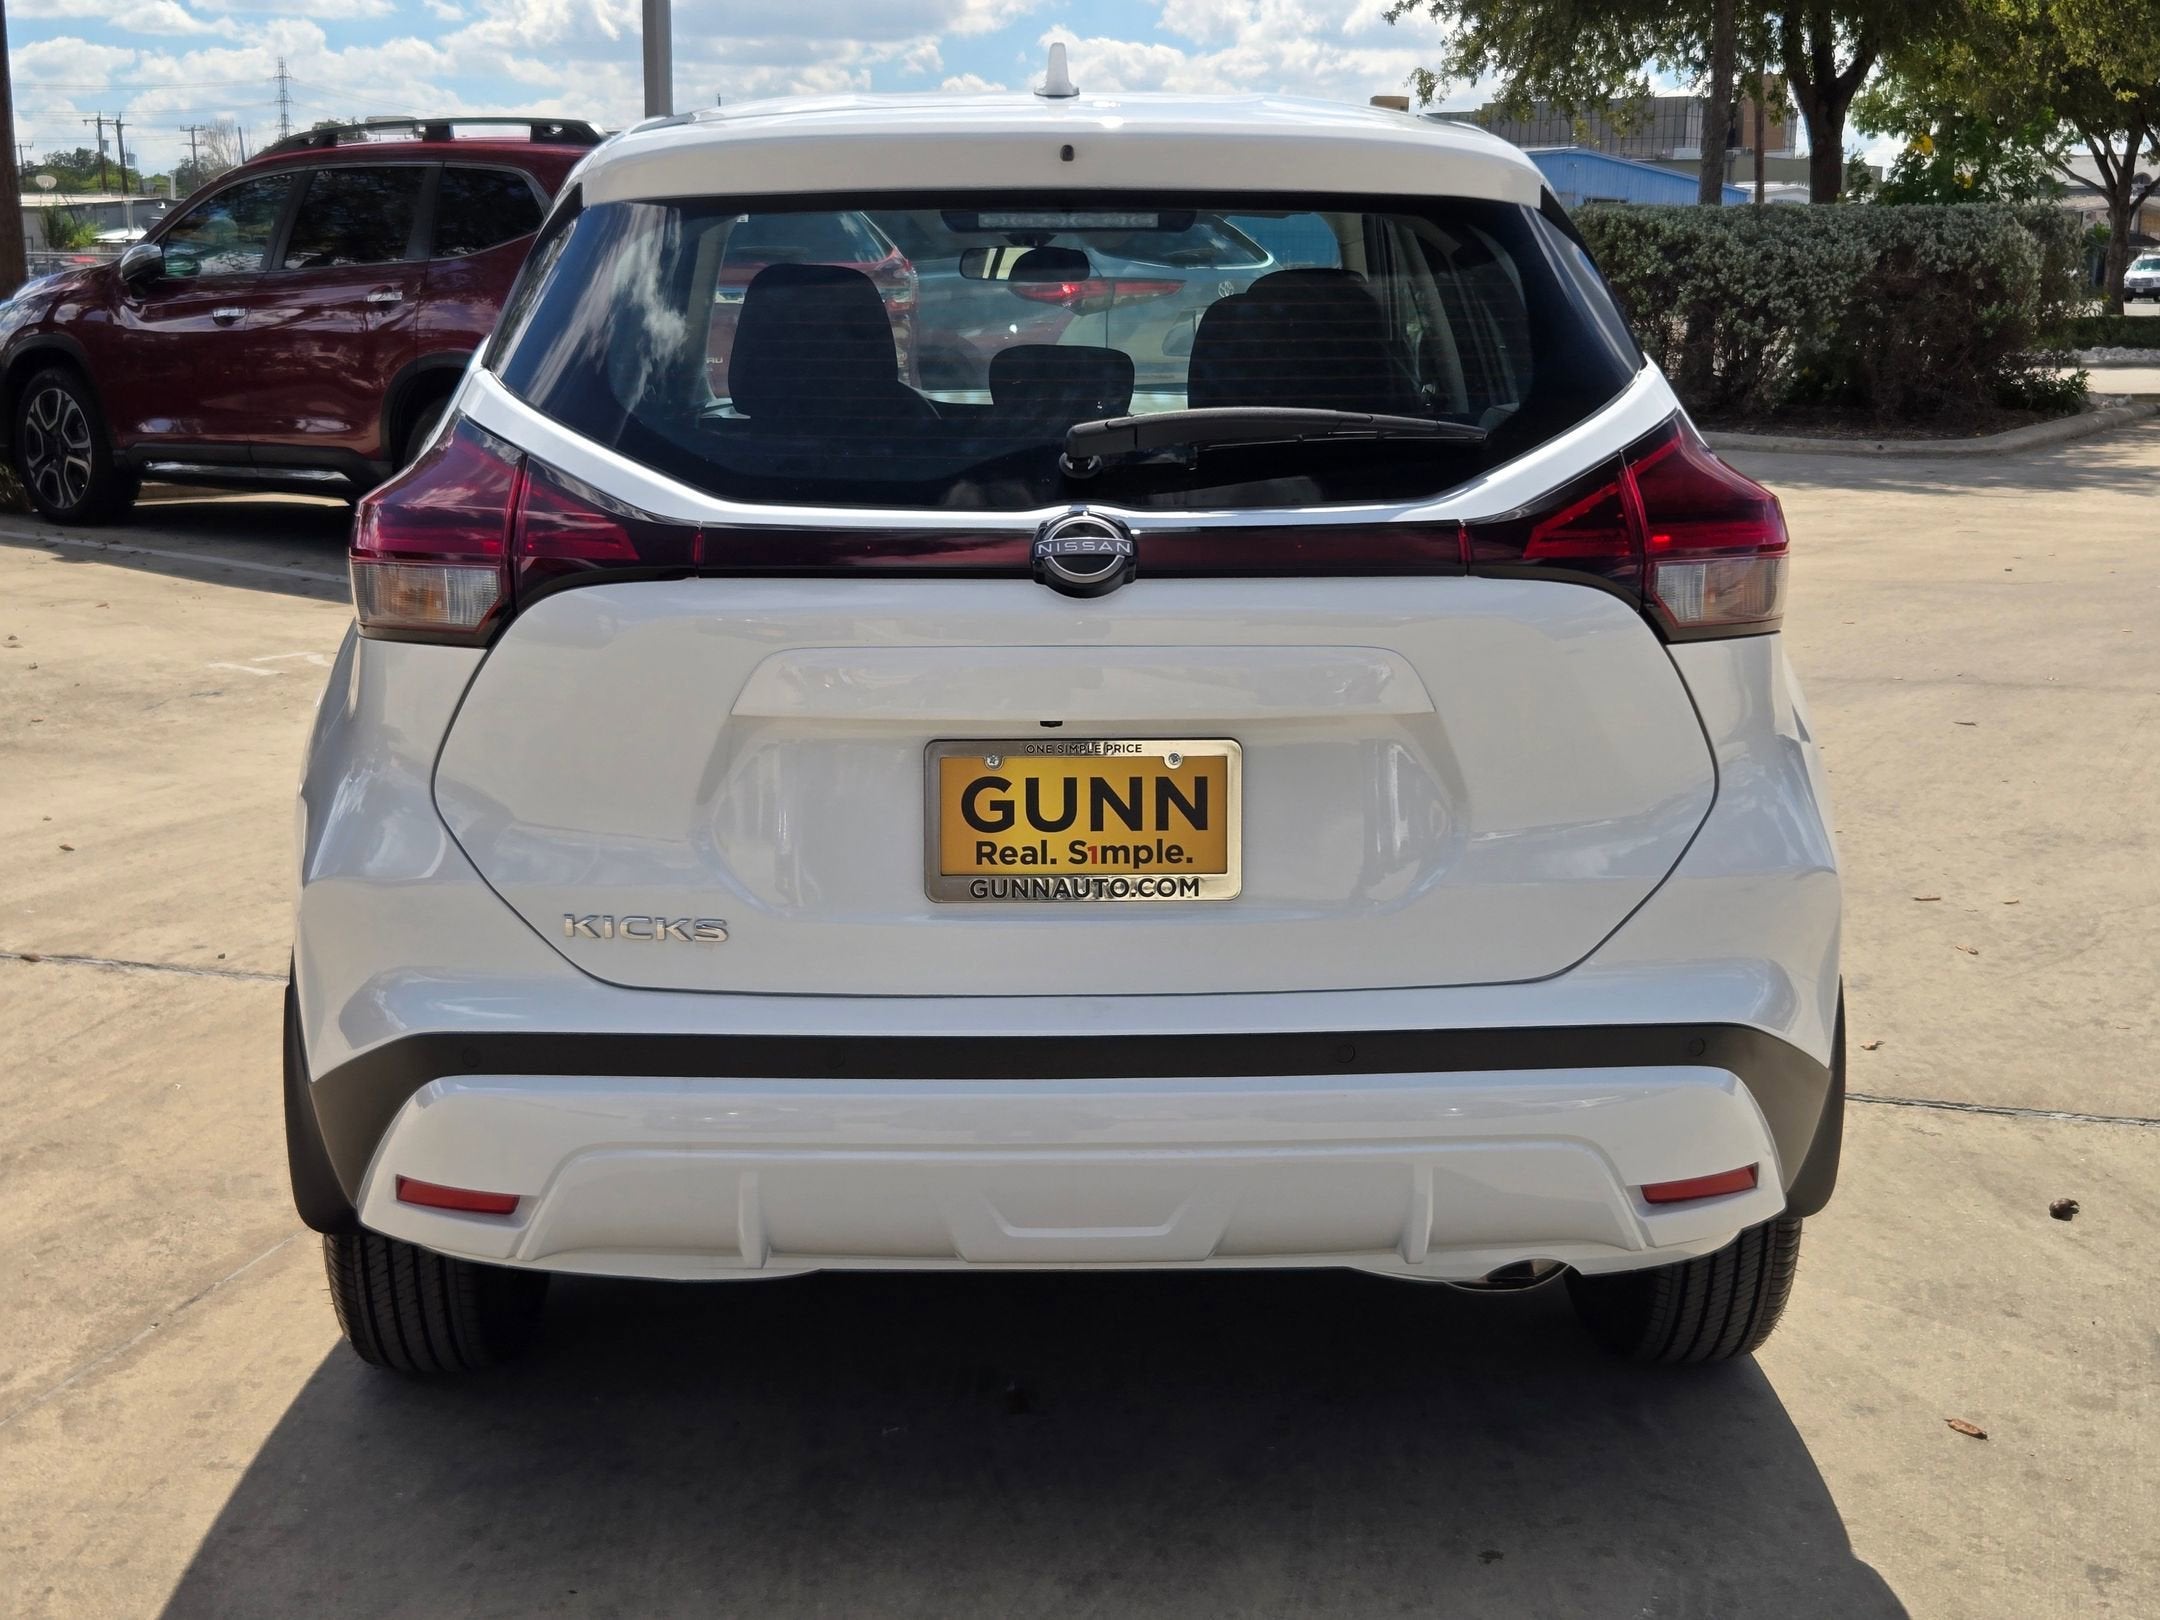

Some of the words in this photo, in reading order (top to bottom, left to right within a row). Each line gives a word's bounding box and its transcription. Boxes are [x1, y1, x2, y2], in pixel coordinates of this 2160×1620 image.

[1038, 541, 1131, 554] NISSAN
[1026, 744, 1053, 754] ONE
[1057, 743, 1102, 754] SIMPLE
[1105, 743, 1143, 754] PRICE
[961, 776, 1208, 833] GUNN
[975, 840, 1057, 866] Real.
[969, 877, 1200, 899] GUNNAUTO.COM
[563, 913, 730, 943] KICKS
